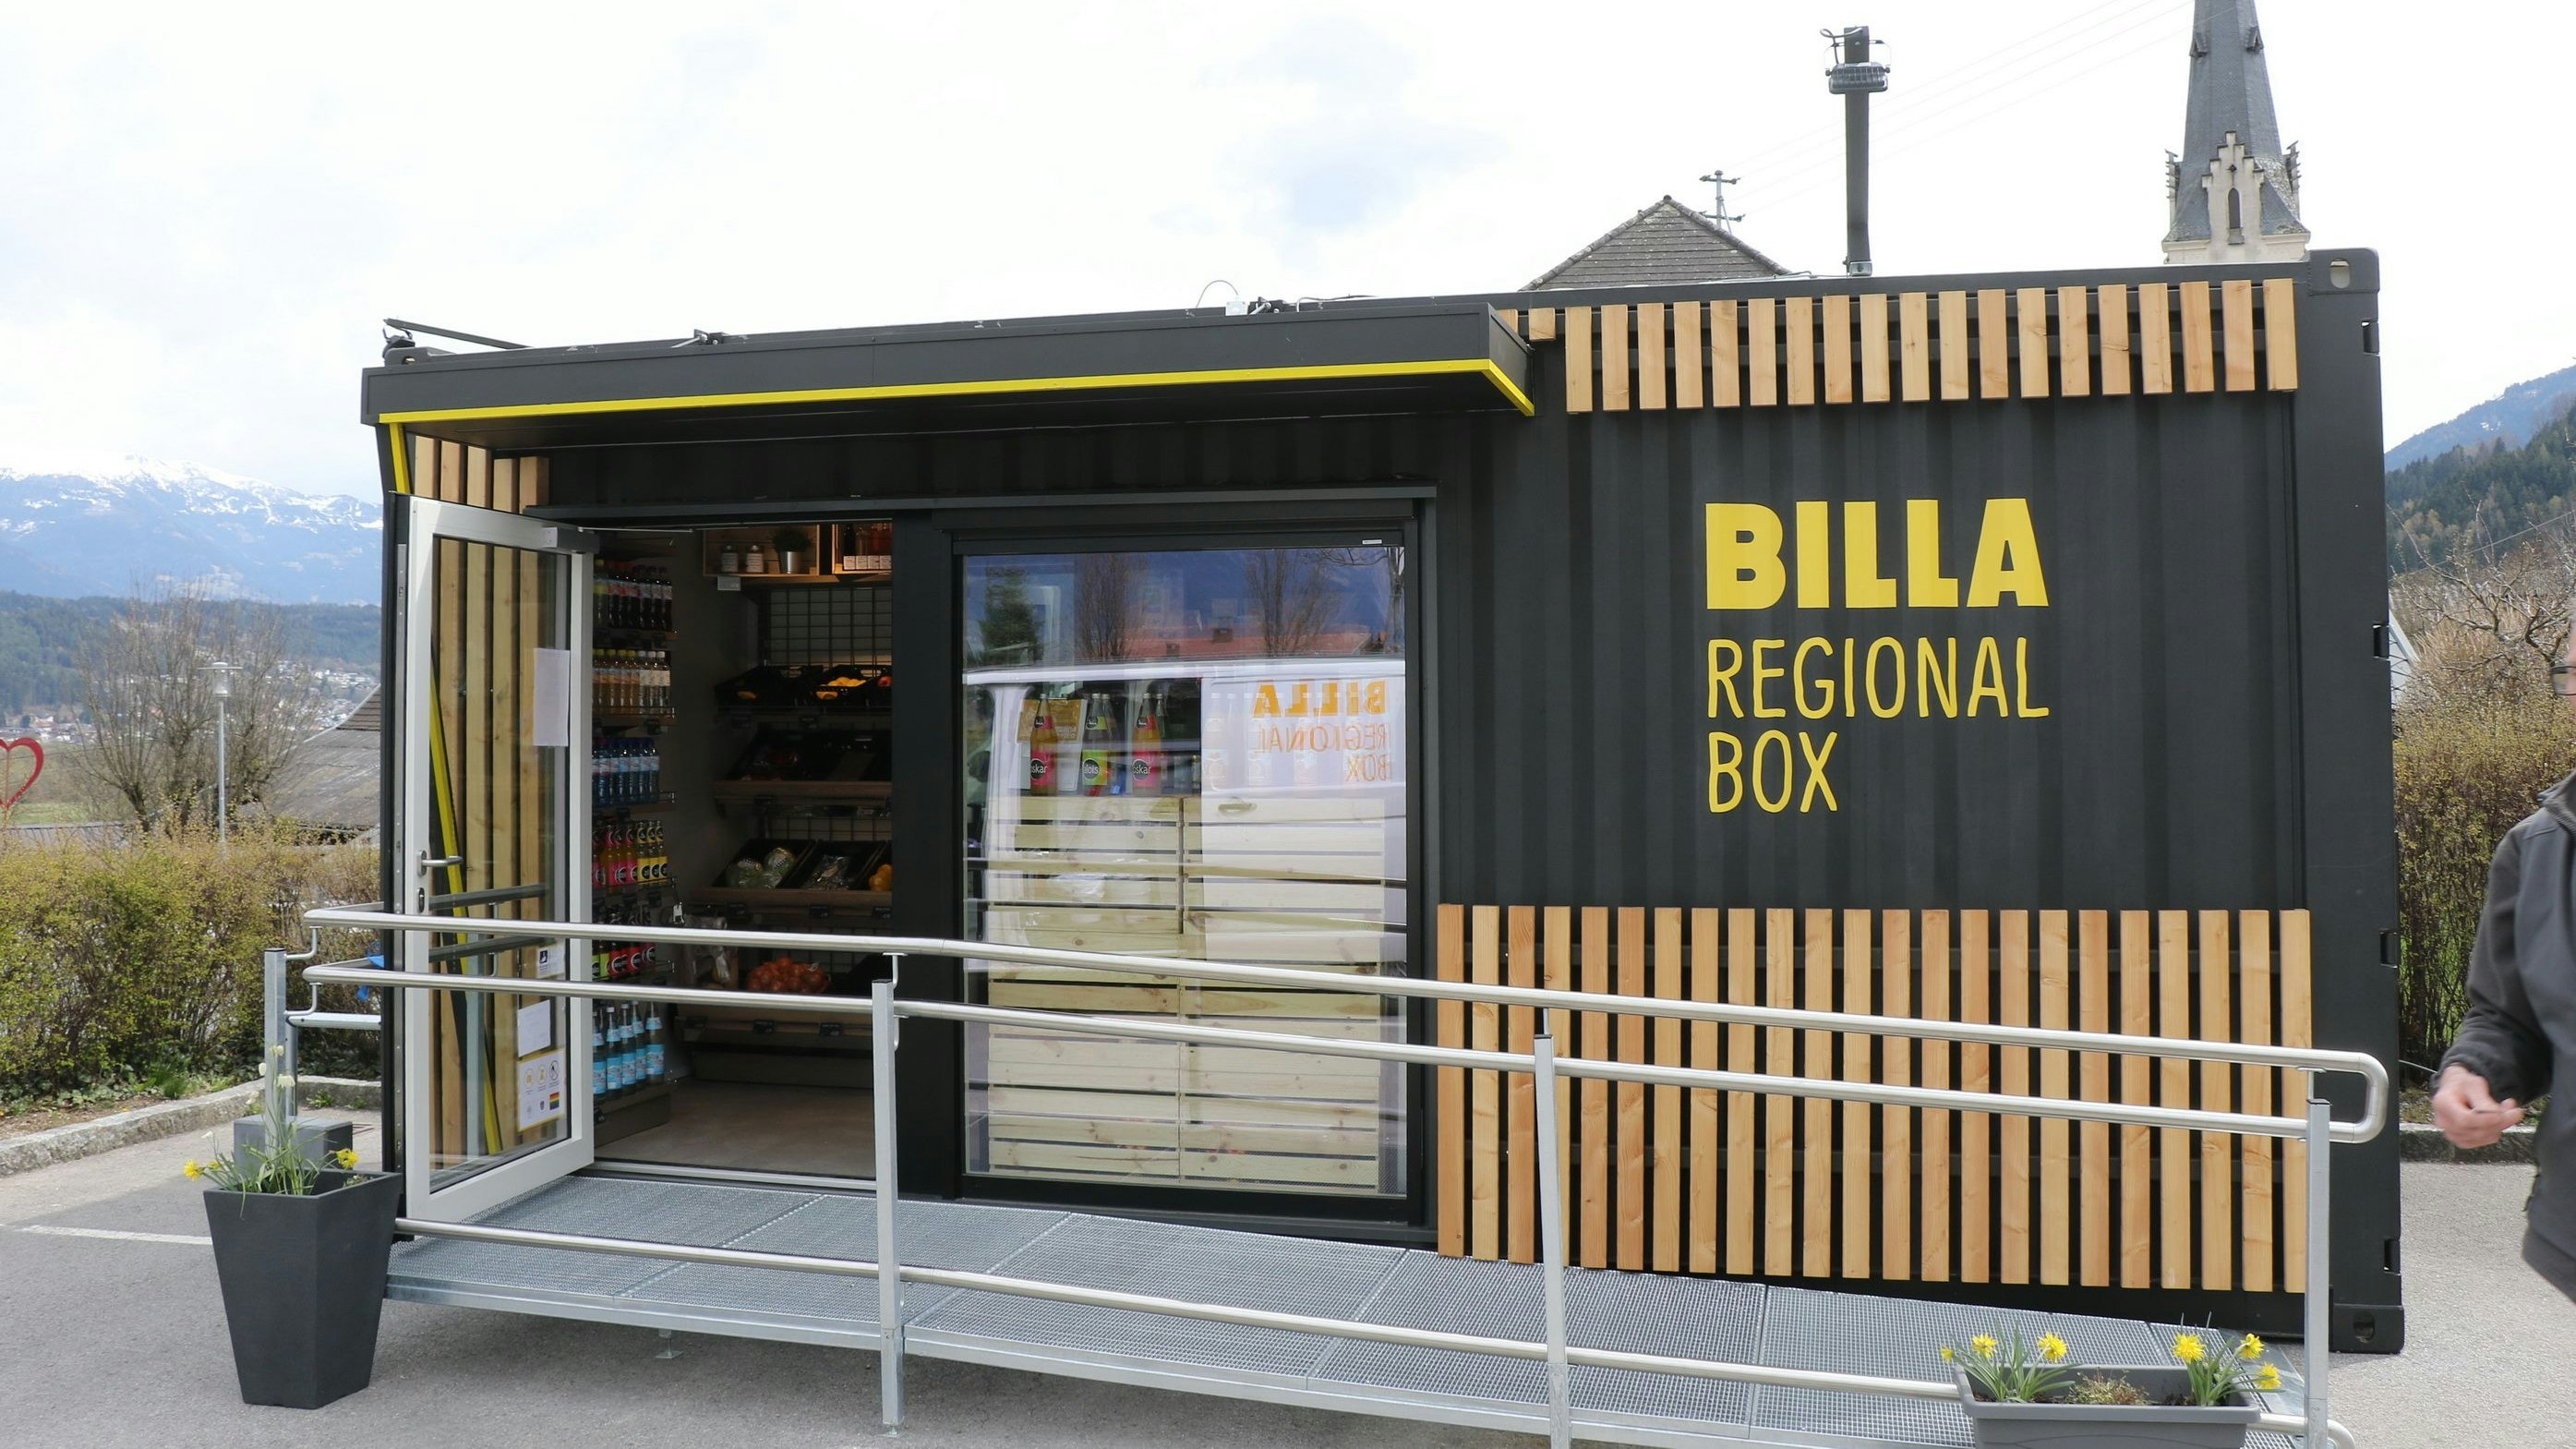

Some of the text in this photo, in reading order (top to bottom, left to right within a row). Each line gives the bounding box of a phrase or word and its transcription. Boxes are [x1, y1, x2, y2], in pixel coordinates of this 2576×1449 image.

[1705, 499, 2050, 610] BILLA
[1707, 637, 2050, 719] REGIONAL
[1708, 730, 1837, 813] BOX
